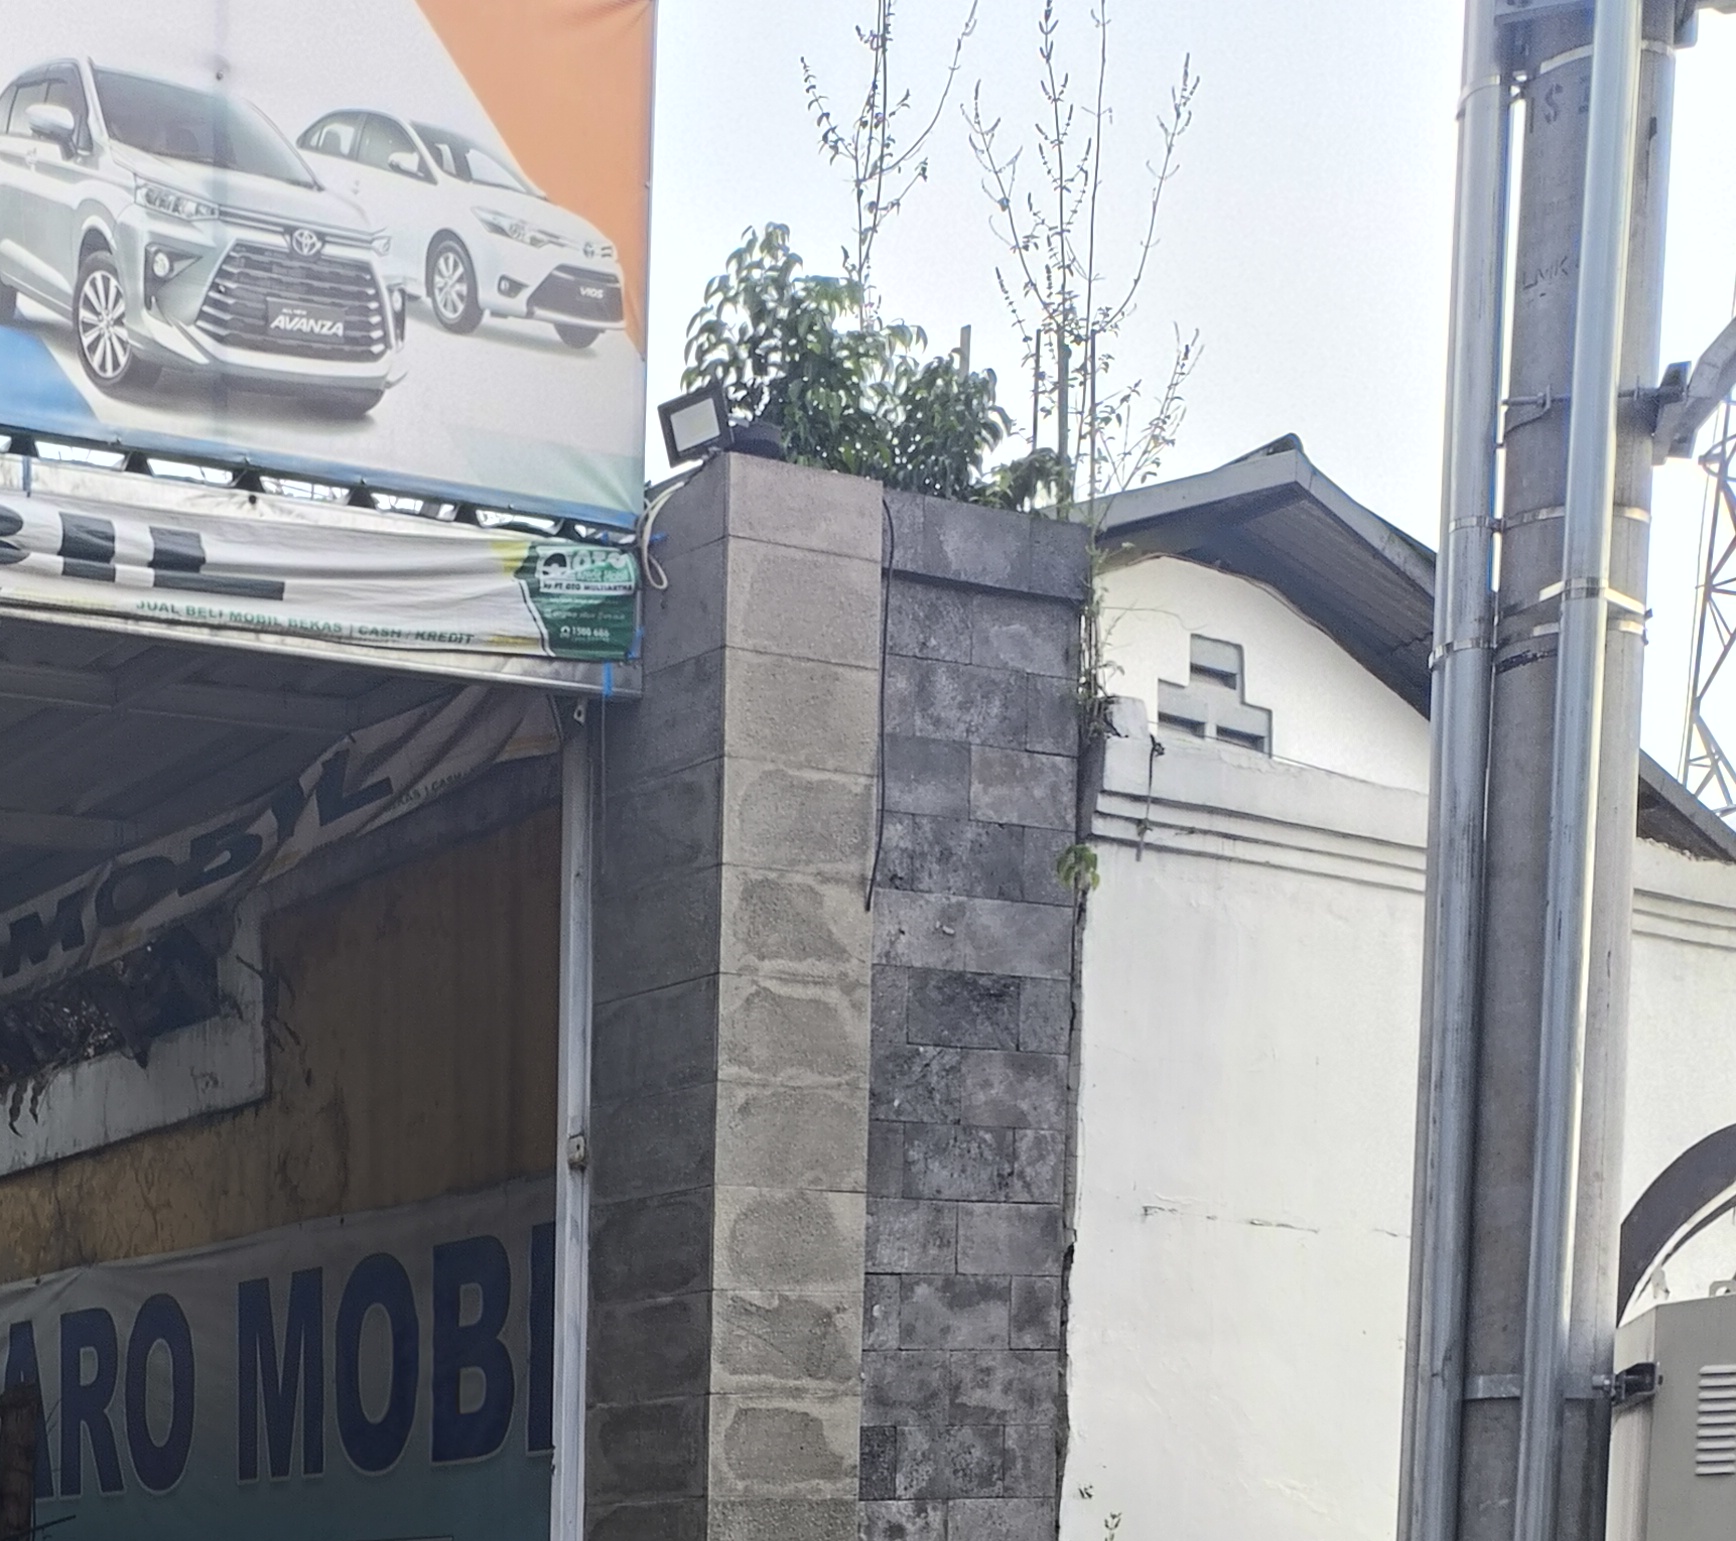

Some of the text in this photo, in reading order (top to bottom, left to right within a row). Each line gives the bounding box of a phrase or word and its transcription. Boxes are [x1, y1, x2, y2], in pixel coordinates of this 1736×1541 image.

[579, 286, 605, 299] VIOS
[269, 314, 345, 338] AVANZA
[135, 600, 181, 617] JUAL
[185, 605, 224, 620] BELI
[229, 610, 283, 628] MOBIL
[287, 617, 343, 635] BEKAS
[357, 625, 403, 640] CASH
[414, 629, 476, 646] KREDIT
